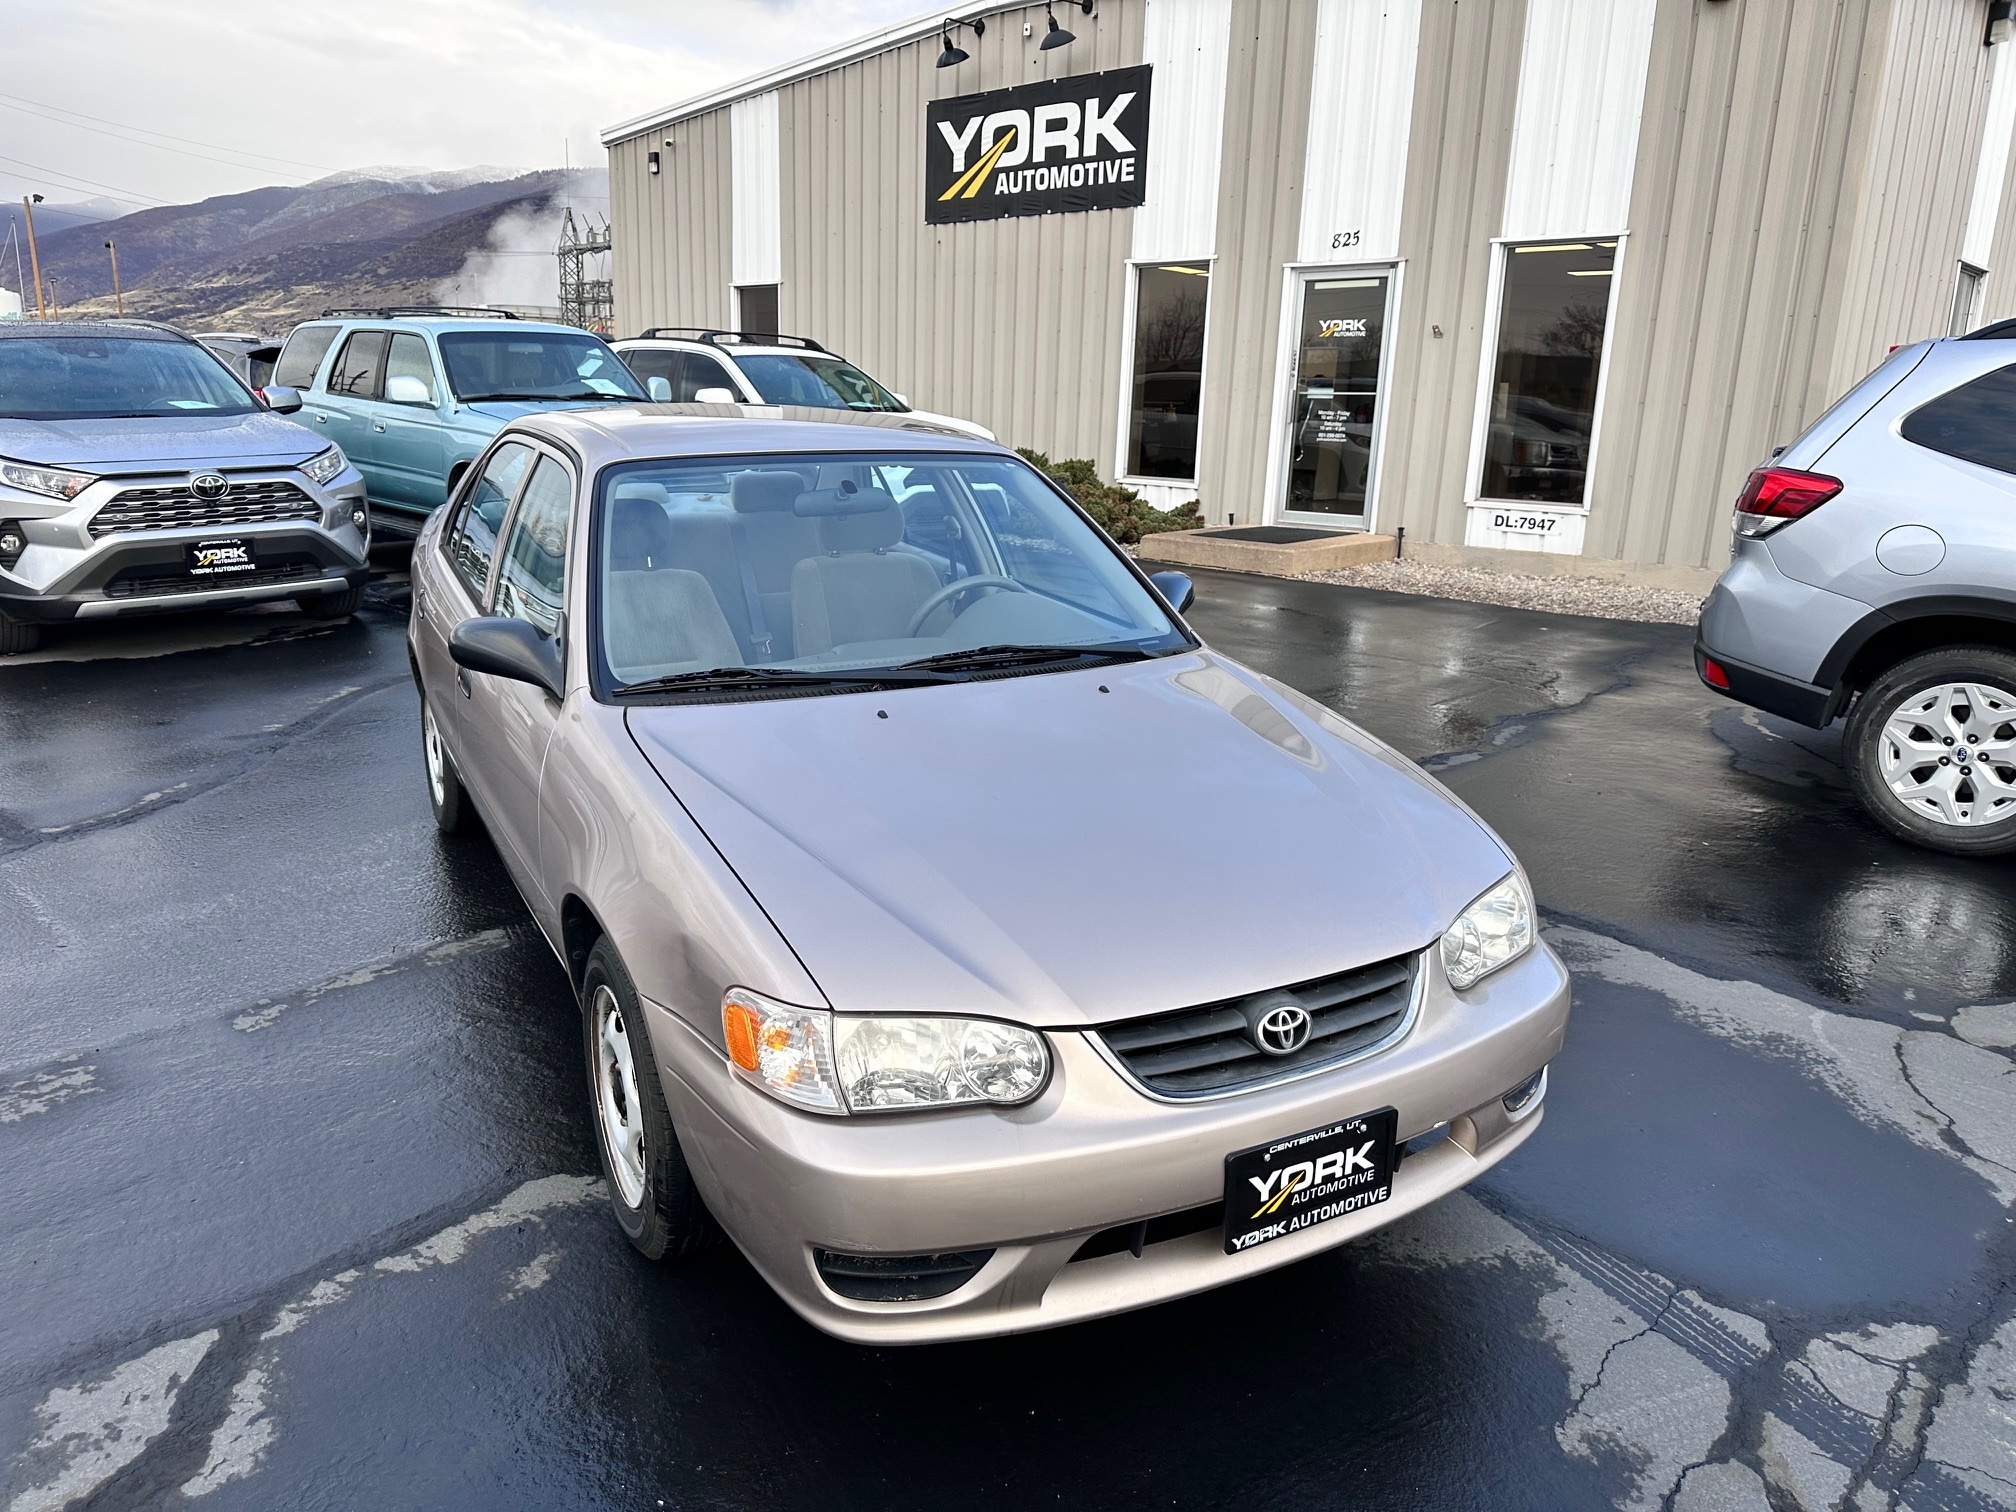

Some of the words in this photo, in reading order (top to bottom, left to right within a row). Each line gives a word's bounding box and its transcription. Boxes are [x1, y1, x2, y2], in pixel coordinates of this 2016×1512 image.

[937, 91, 1137, 173] YORK
[994, 157, 1135, 195] AUTOMOTIVE
[1331, 230, 1360, 249] 825
[1319, 319, 1367, 332] YORK
[1494, 515, 1556, 531] DL:7947
[190, 567, 214, 575] YORK
[214, 564, 256, 573] AUTOMOTIVE
[193, 547, 247, 561] YORK
[1269, 1125, 1344, 1154] CENTERVILLE,
[1346, 1119, 1362, 1130] UT
[1248, 1140, 1376, 1202] YORK
[1291, 1169, 1375, 1206] AUTOMOTIVE
[1231, 1220, 1287, 1250] YORK
[1289, 1186, 1388, 1231] AUTOMOTIVE
